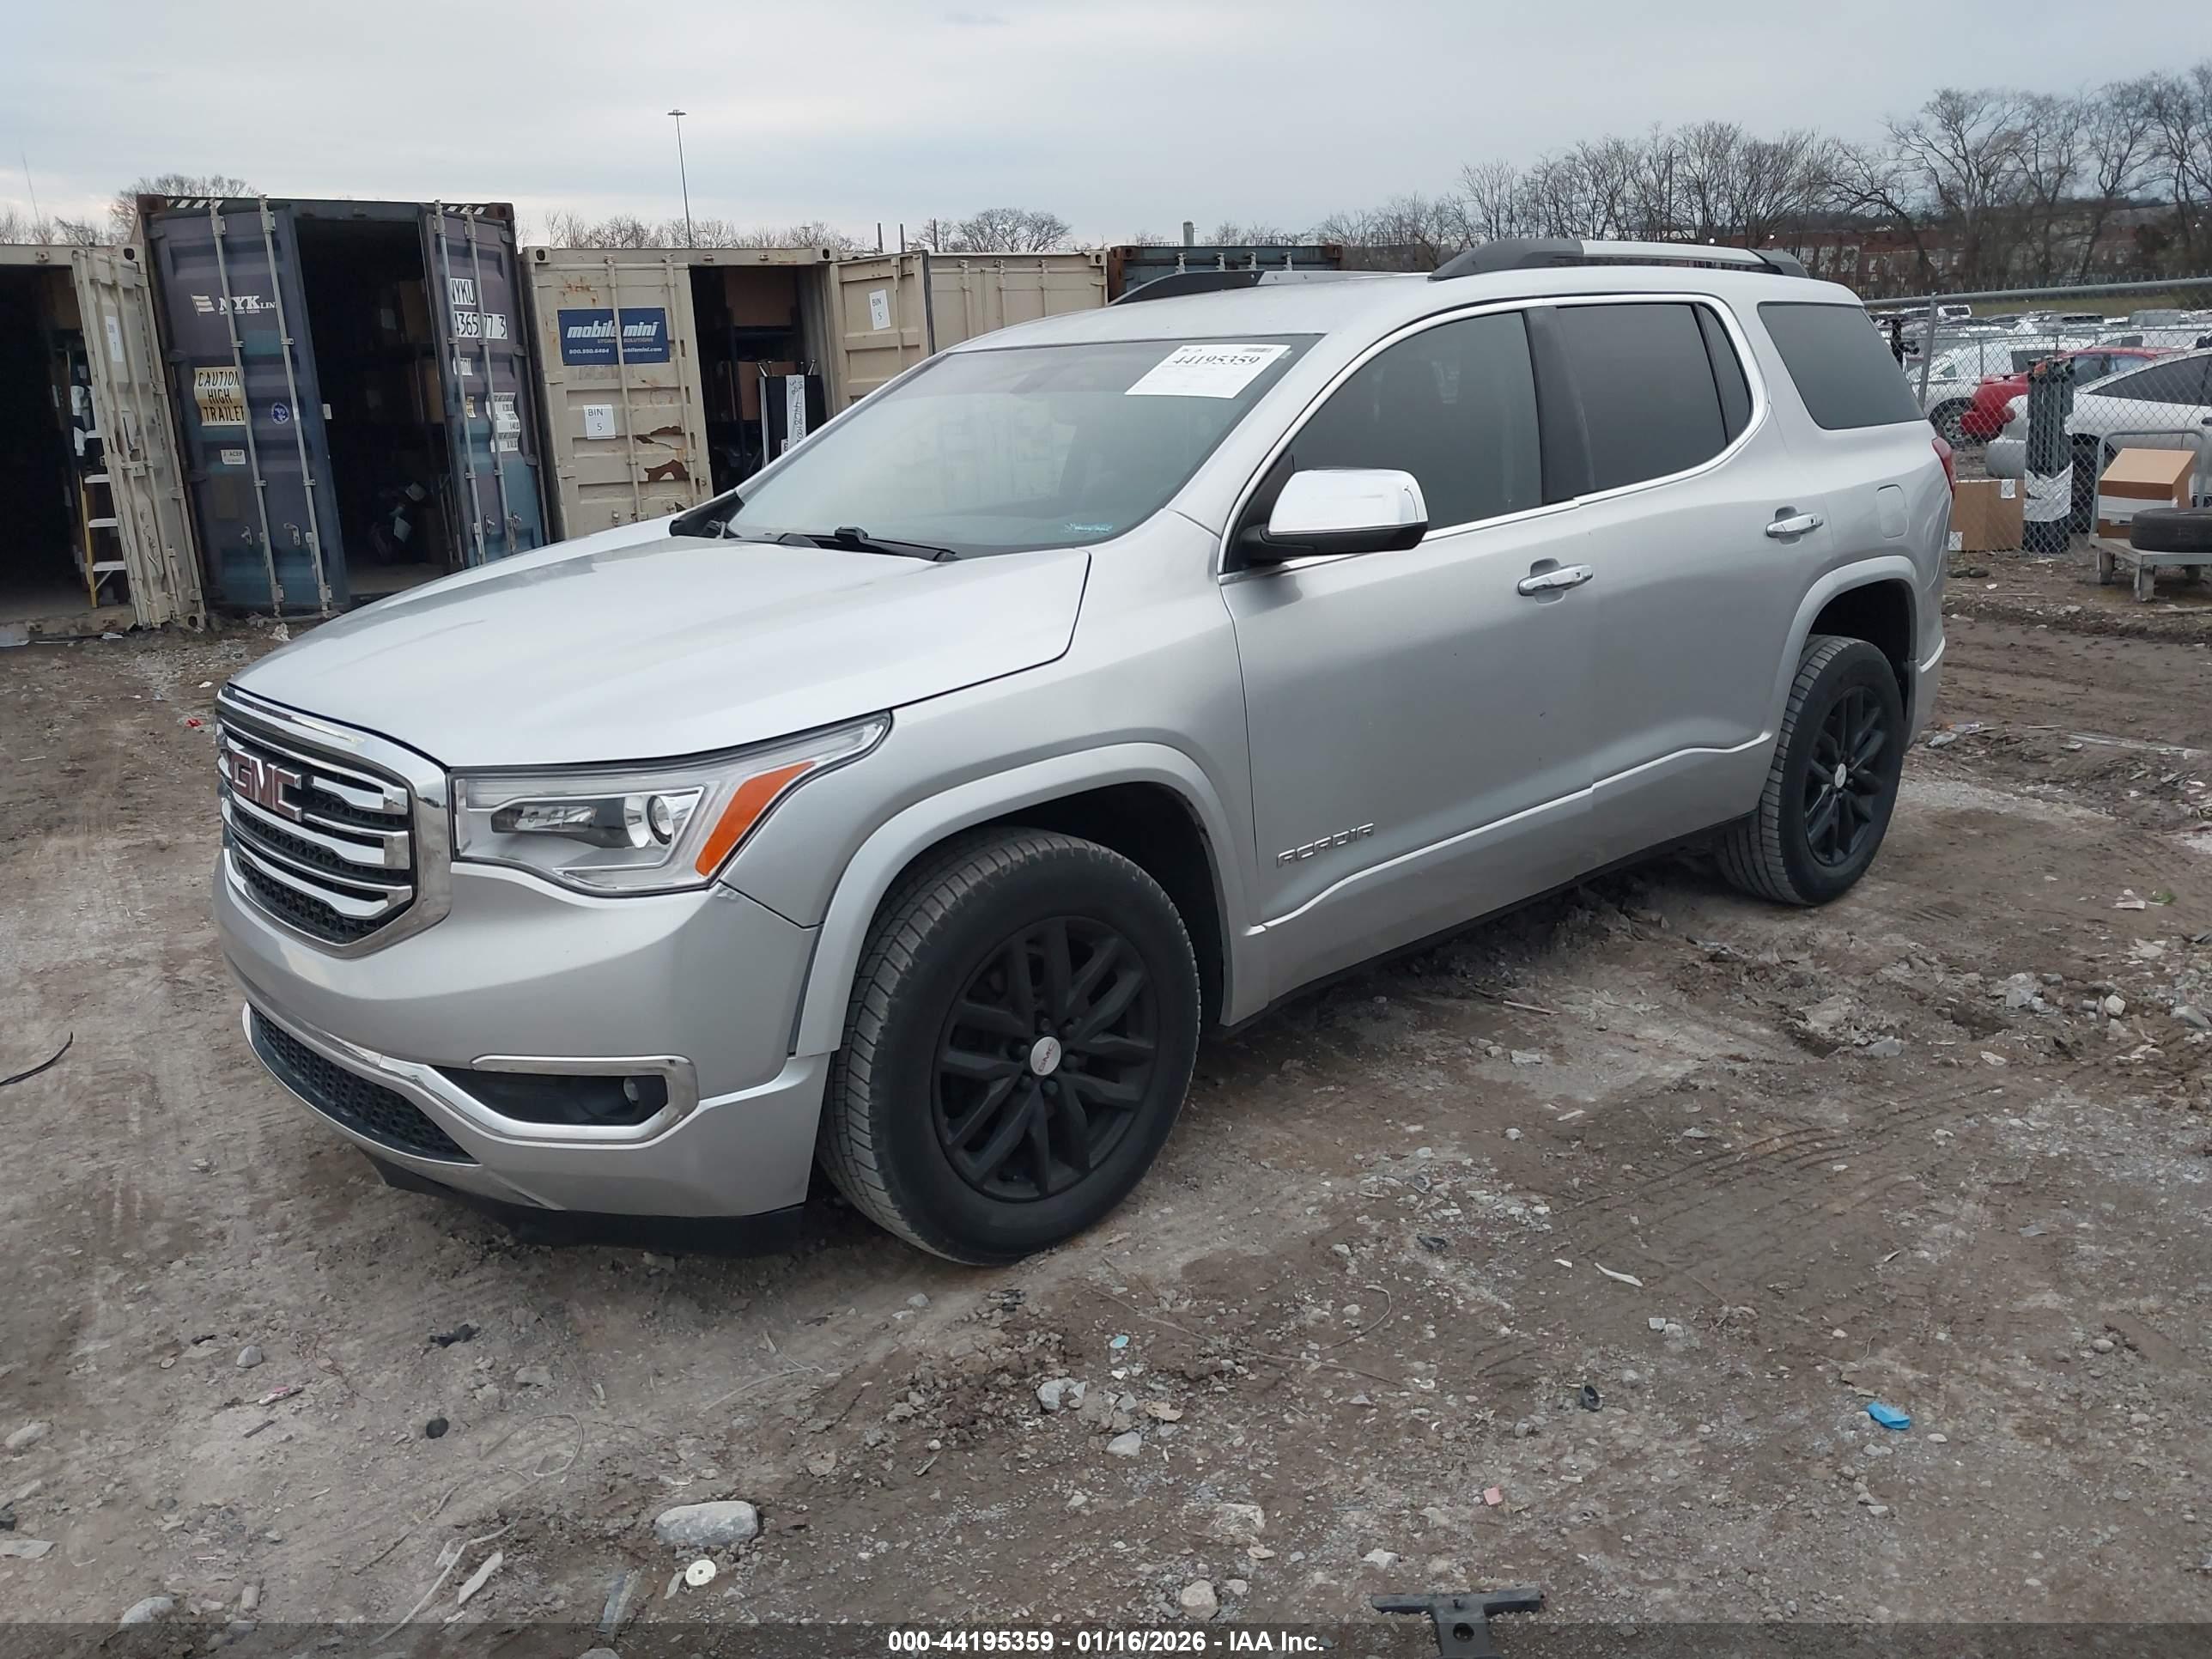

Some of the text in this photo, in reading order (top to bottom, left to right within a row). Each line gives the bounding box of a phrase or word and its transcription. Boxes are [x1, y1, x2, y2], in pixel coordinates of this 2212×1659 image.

[219, 295, 260, 310] NYK
[499, 316, 507, 337] 3
[567, 320, 657, 338] mobile mini
[1173, 356, 1261, 365] 44195359
[208, 388, 232, 404] HIGH
[587, 408, 604, 416] BIN
[597, 422, 603, 431] 5
[231, 749, 302, 823] GMC
[1277, 823, 1375, 868] ACADIA
